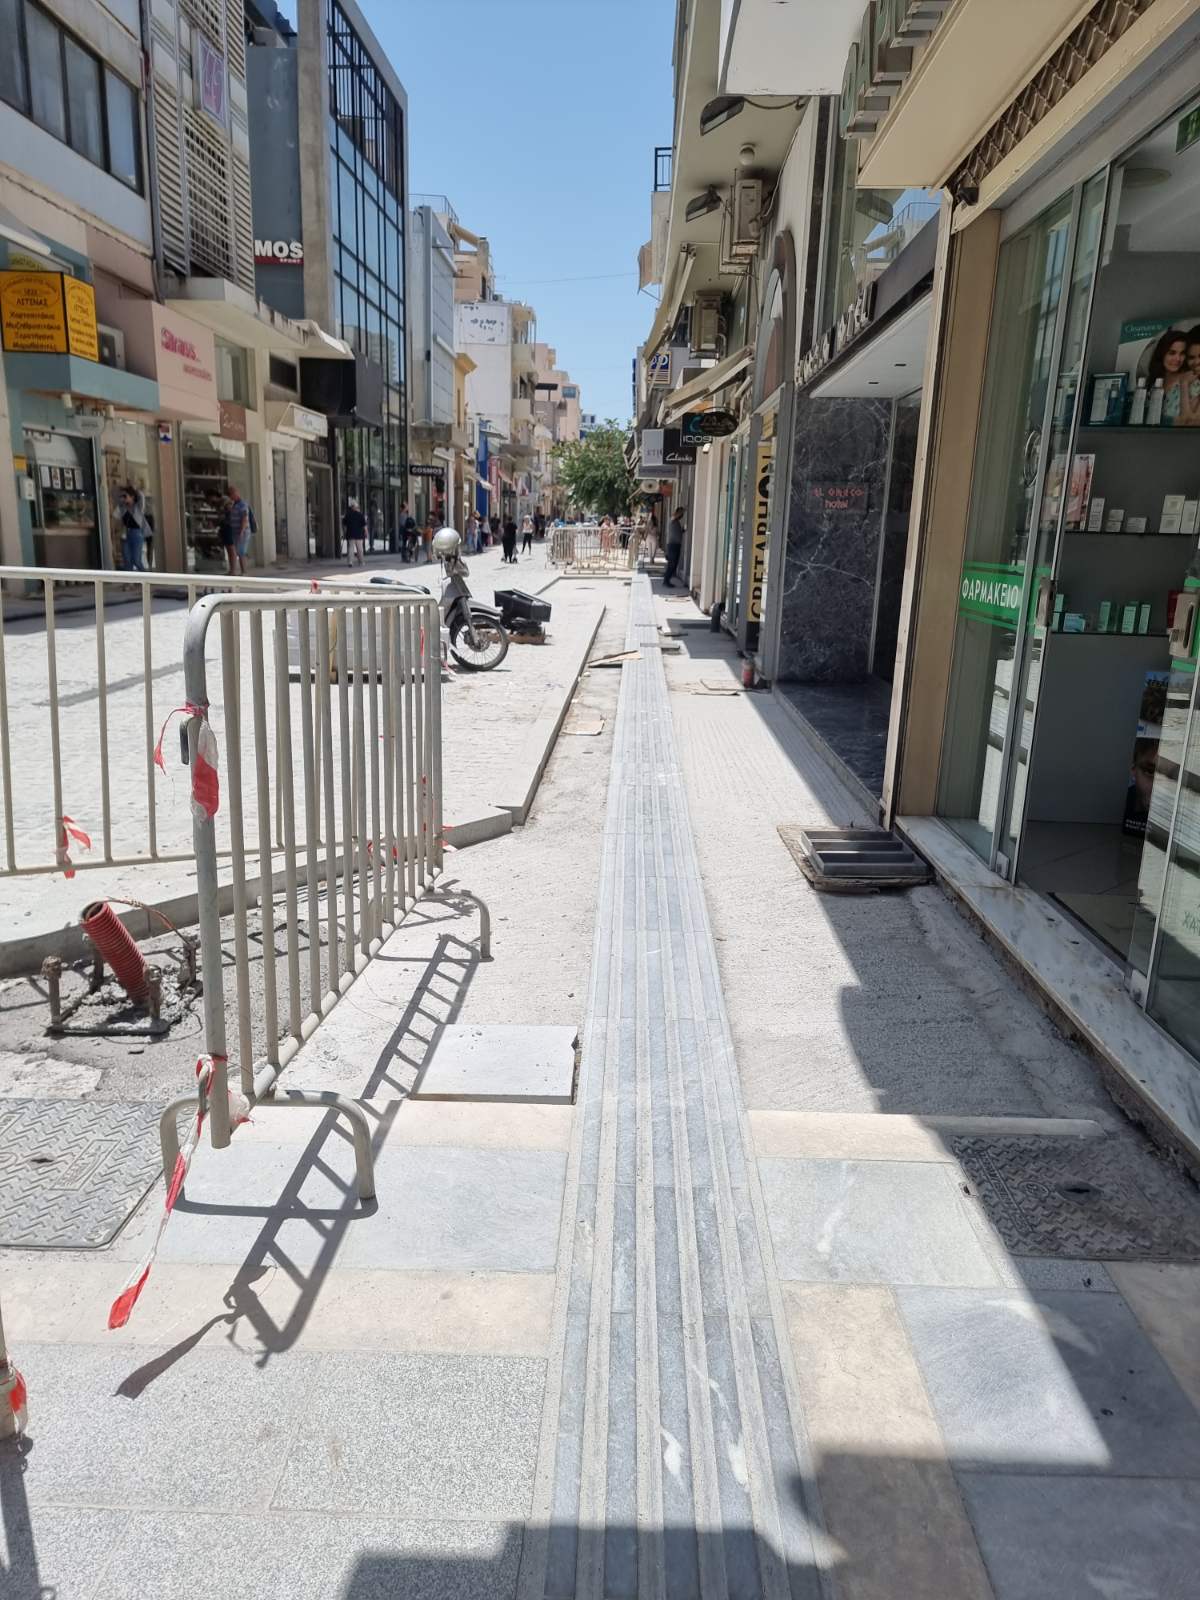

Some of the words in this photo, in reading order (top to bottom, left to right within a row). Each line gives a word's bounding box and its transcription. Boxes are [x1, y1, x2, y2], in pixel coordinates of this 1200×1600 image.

[254, 239, 304, 258] MOS
[682, 435, 712, 443] IQOS
[665, 452, 693, 461] Clarks
[411, 466, 442, 474] COSMOS
[962, 577, 1019, 609] ΦΑΡΜΑΚΕΙΟ
